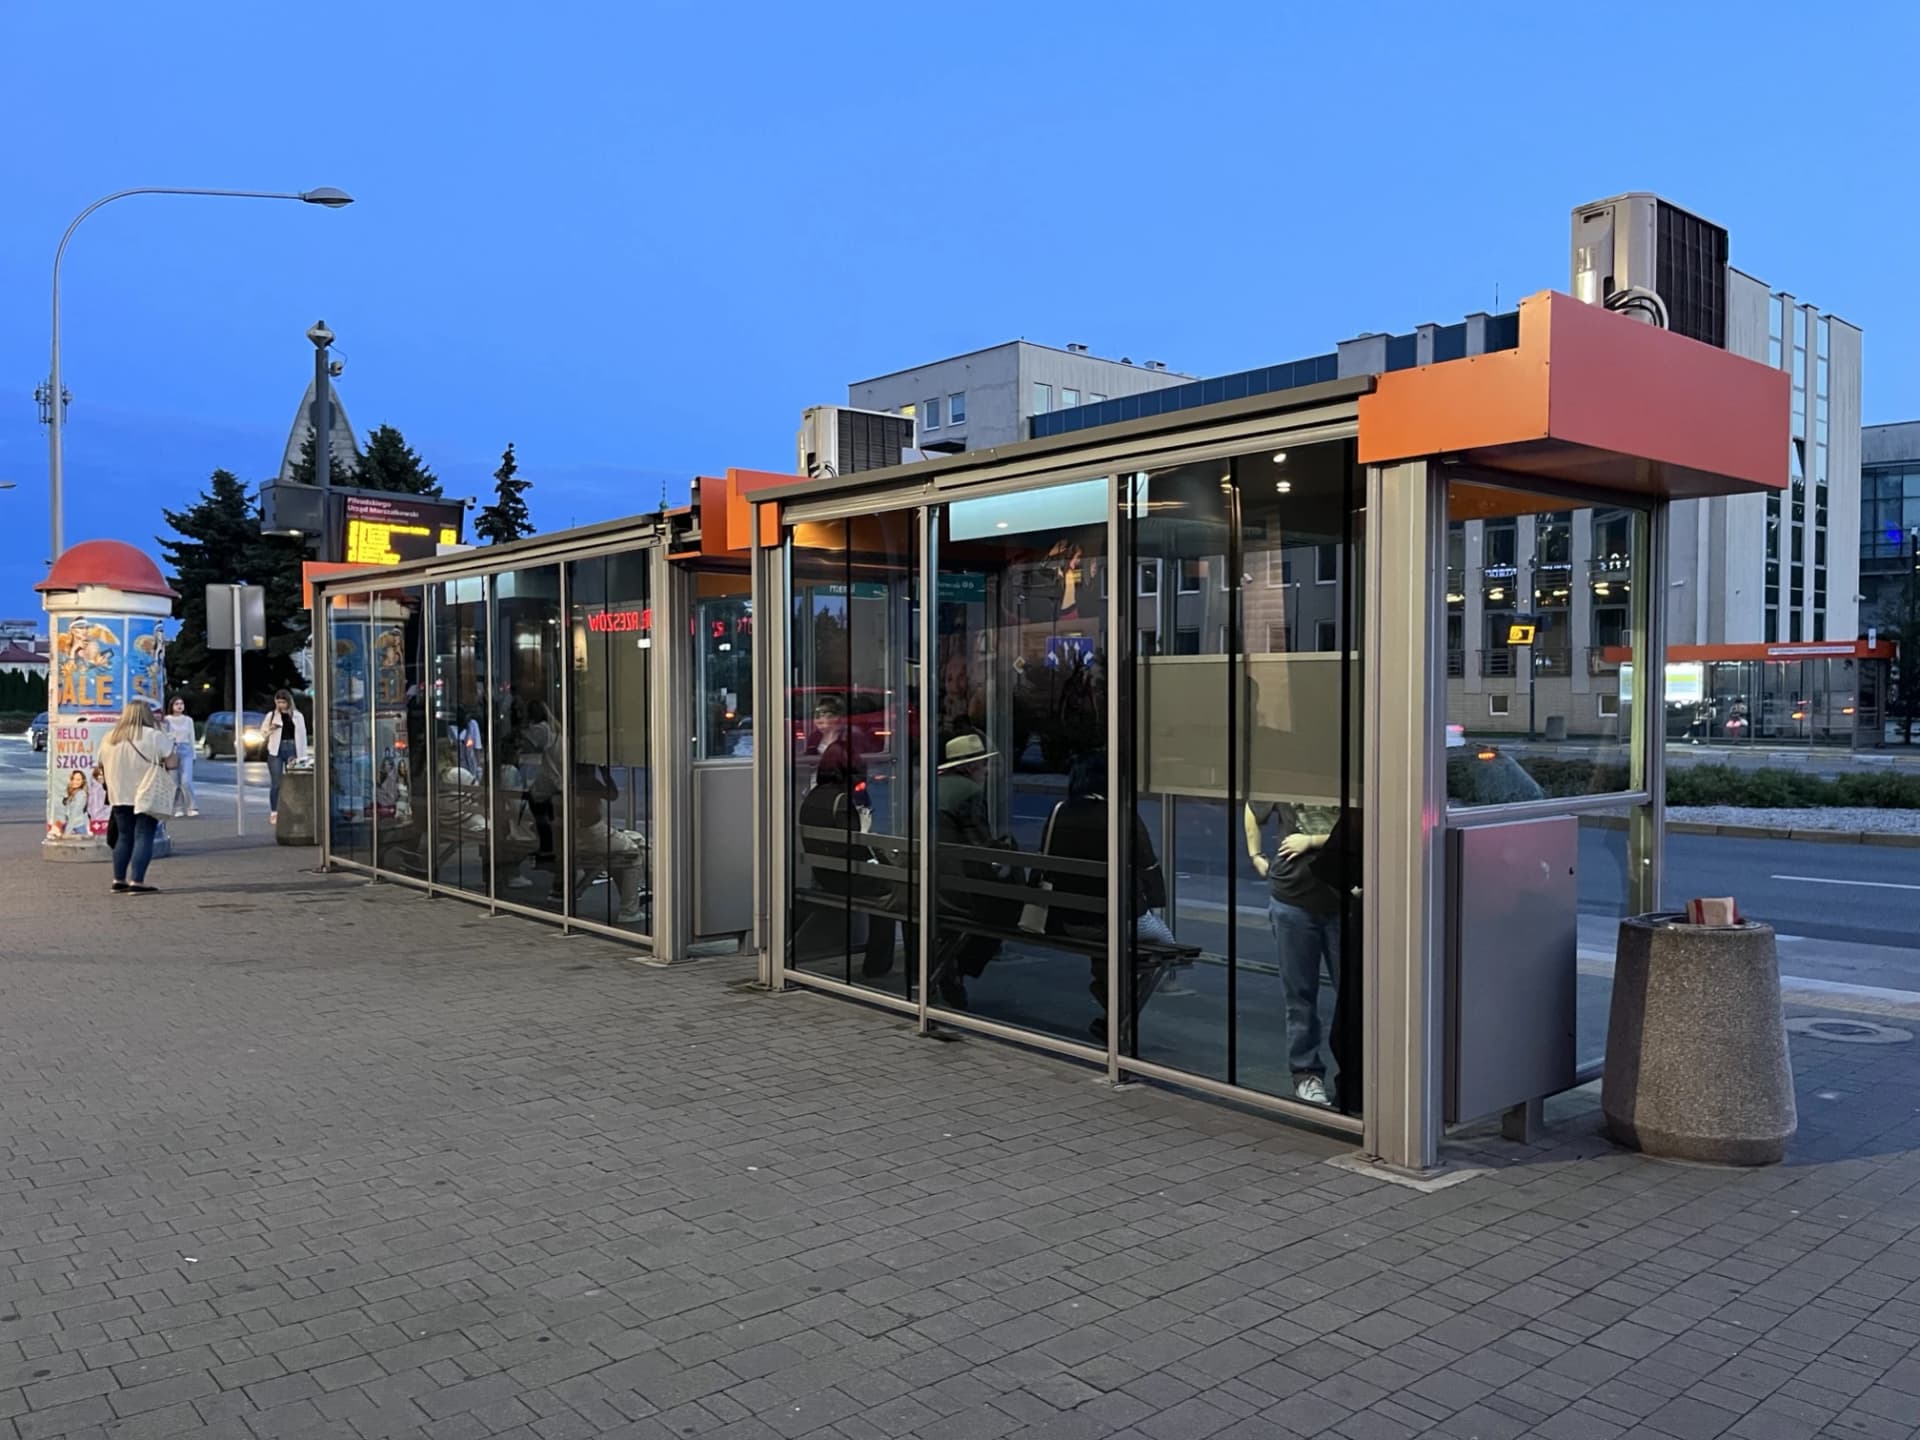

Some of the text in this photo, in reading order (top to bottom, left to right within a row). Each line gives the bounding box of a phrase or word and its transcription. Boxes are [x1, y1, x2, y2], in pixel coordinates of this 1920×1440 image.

[58, 674, 112, 705] ALE
[56, 727, 89, 740] HELLO
[56, 741, 94, 754] WITAJ
